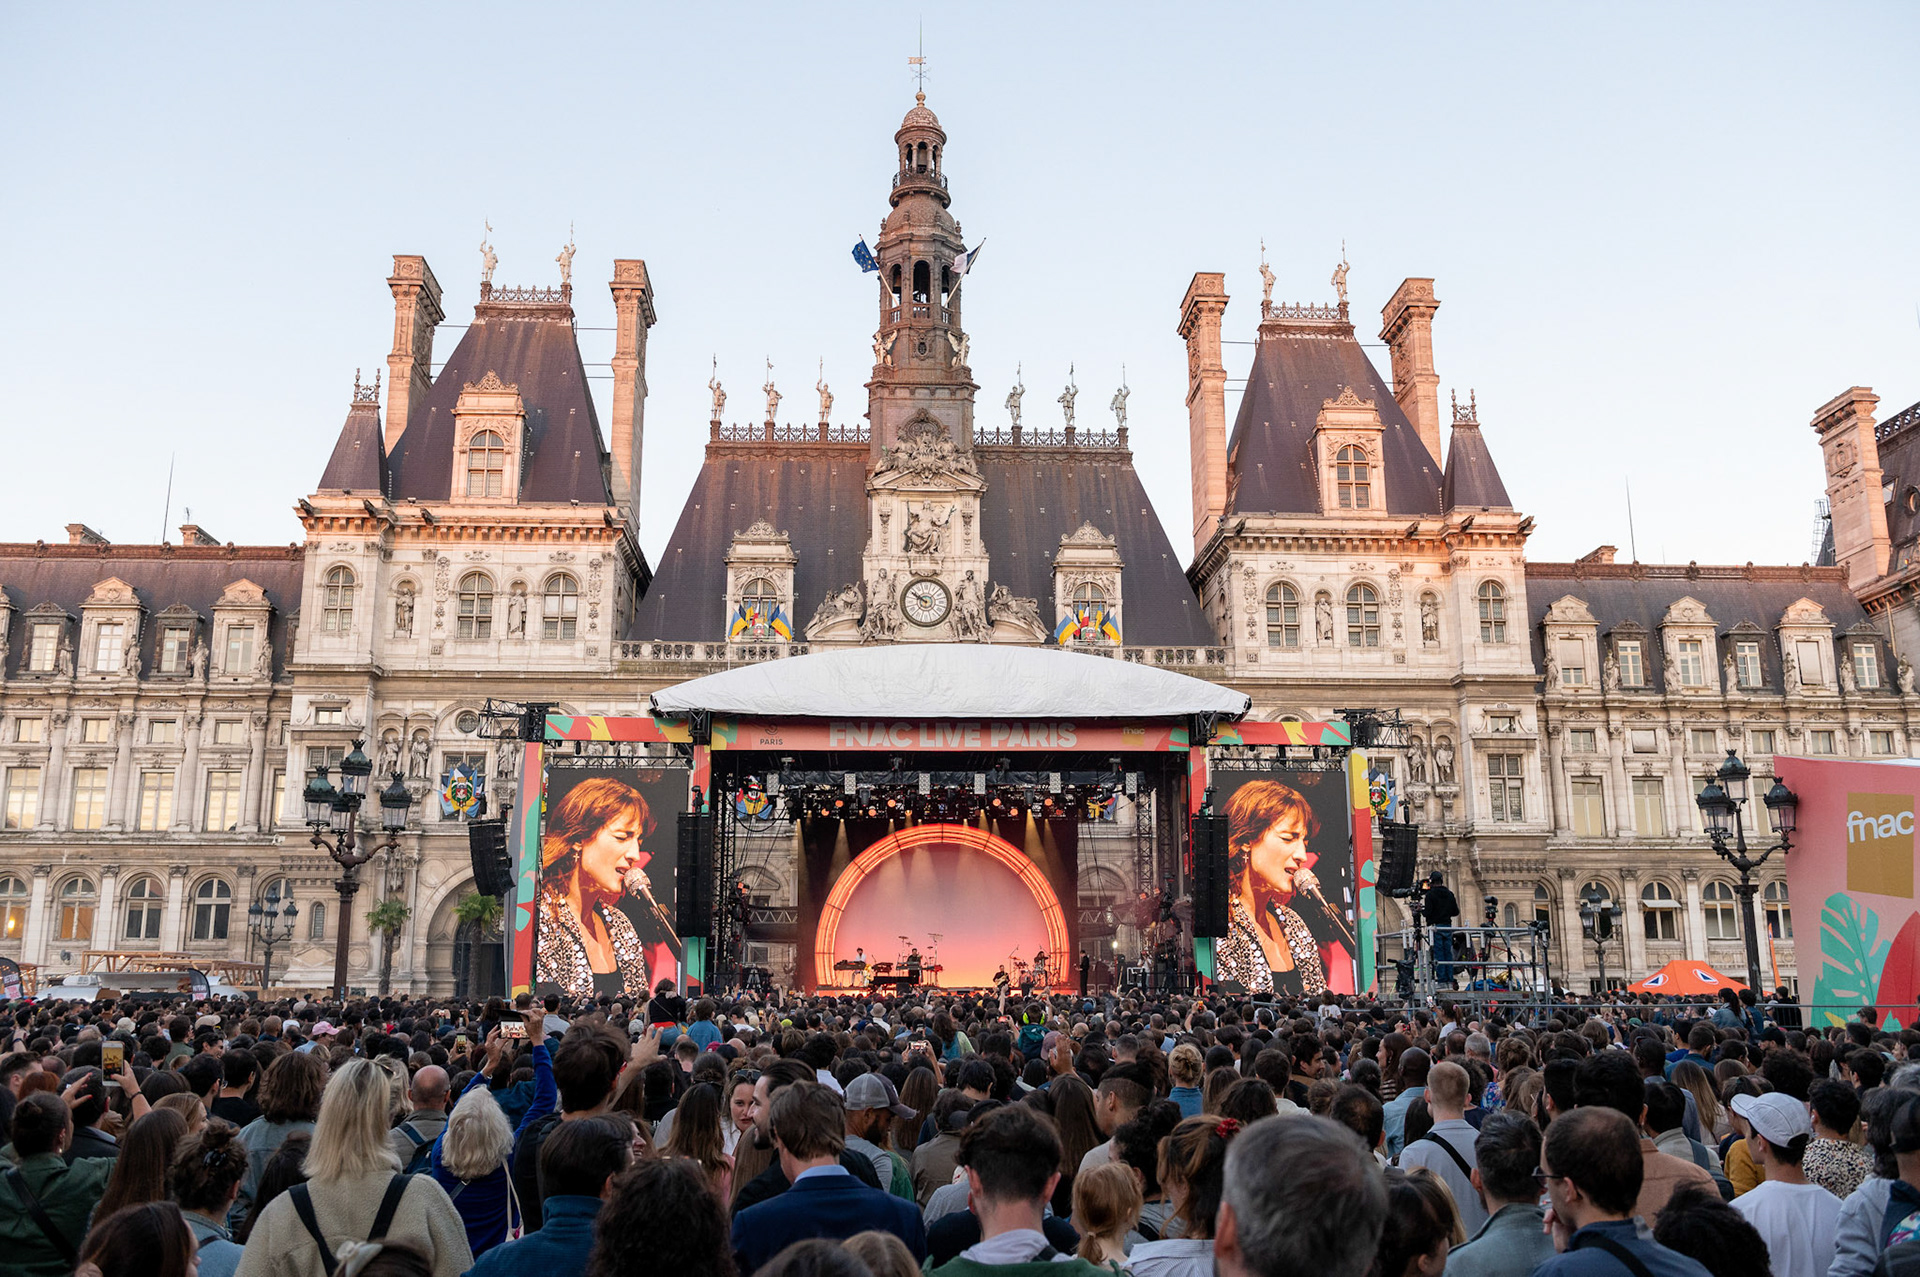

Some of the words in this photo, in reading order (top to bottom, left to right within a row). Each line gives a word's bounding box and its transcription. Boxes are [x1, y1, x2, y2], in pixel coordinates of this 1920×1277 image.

[829, 722, 912, 747] FNAC
[919, 722, 981, 748] LIVE
[991, 722, 1077, 748] PARIS
[1122, 727, 1145, 735] fnac
[1847, 811, 1914, 843] fnac
